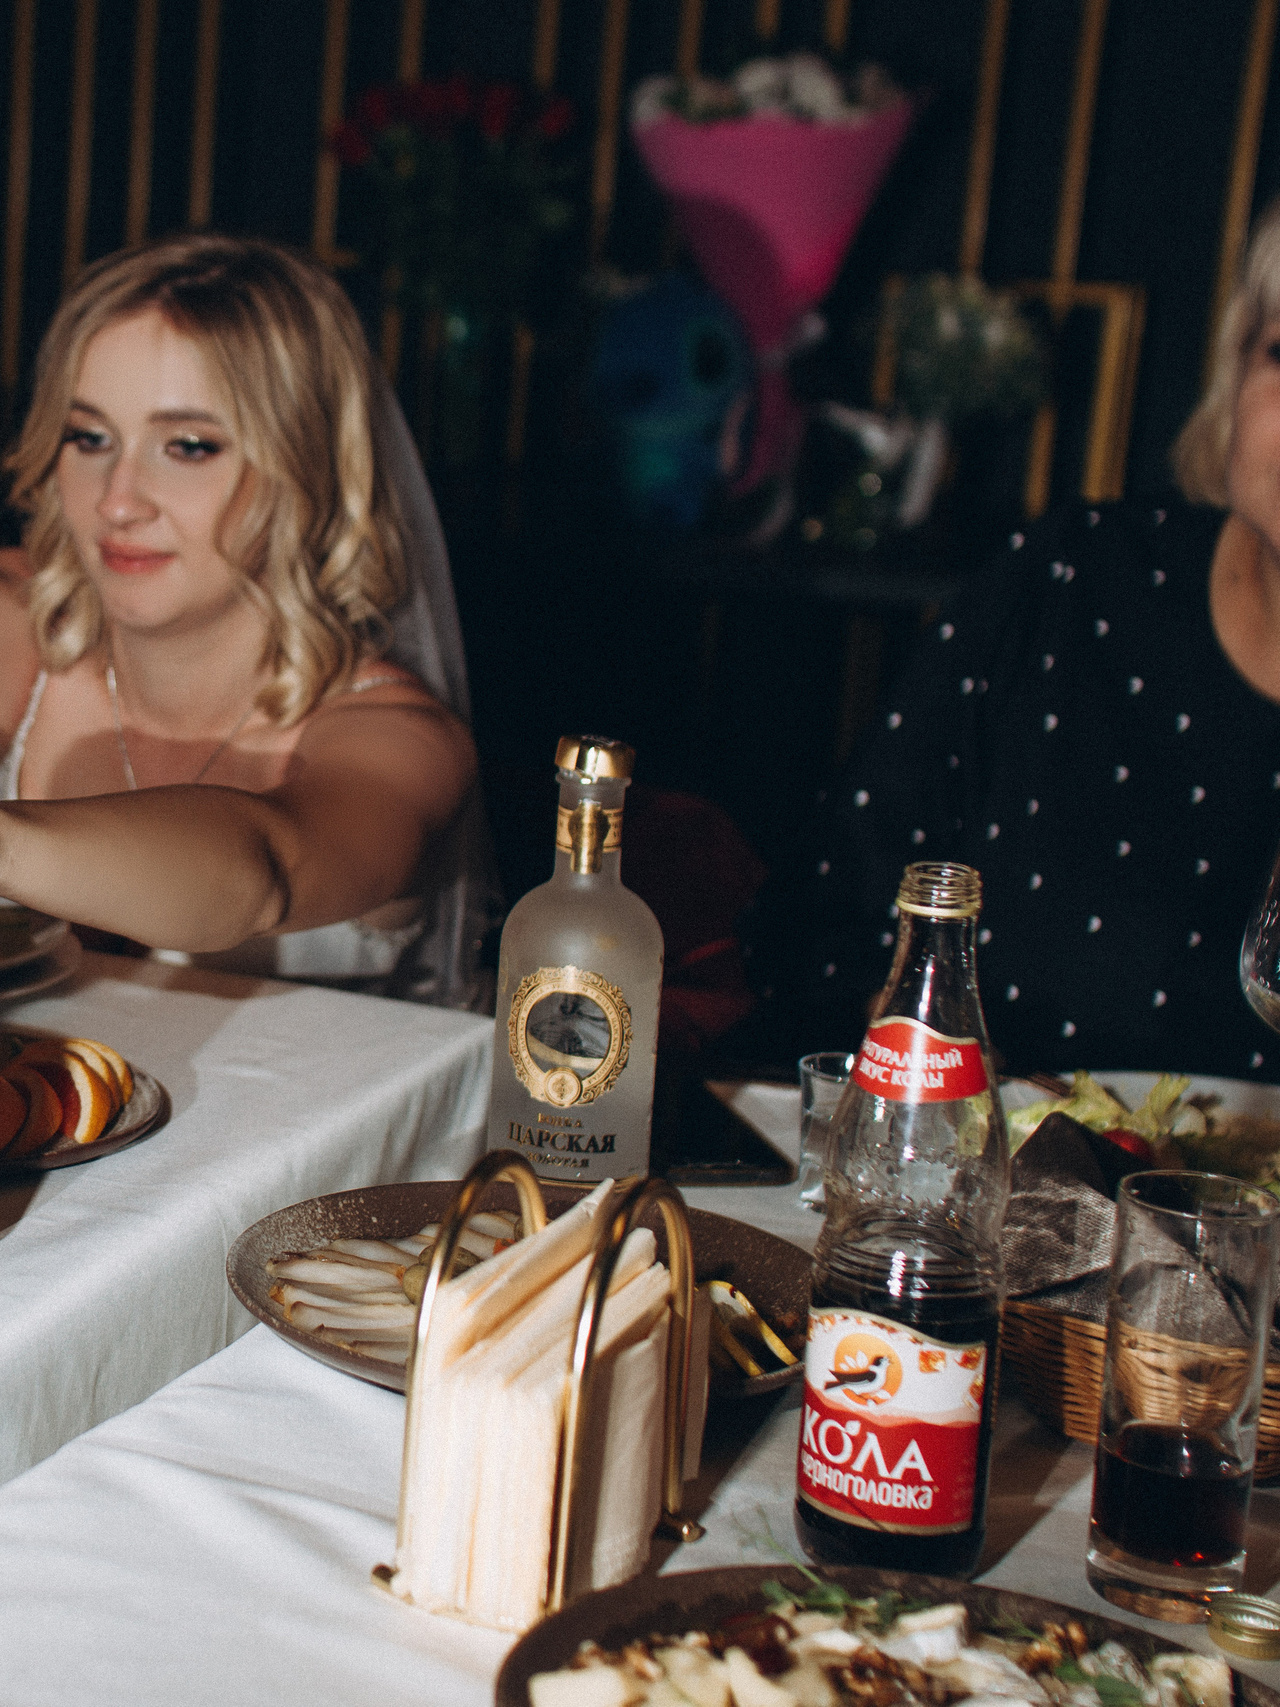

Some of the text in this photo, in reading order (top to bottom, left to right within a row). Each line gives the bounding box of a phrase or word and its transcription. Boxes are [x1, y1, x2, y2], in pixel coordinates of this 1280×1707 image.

[538, 1112, 583, 1128] ВОДКА
[507, 1121, 617, 1154] ЦАРСКАЯ
[526, 1150, 590, 1168] ЗОЛОТАЯ
[802, 1402, 934, 1482] КОЛА
